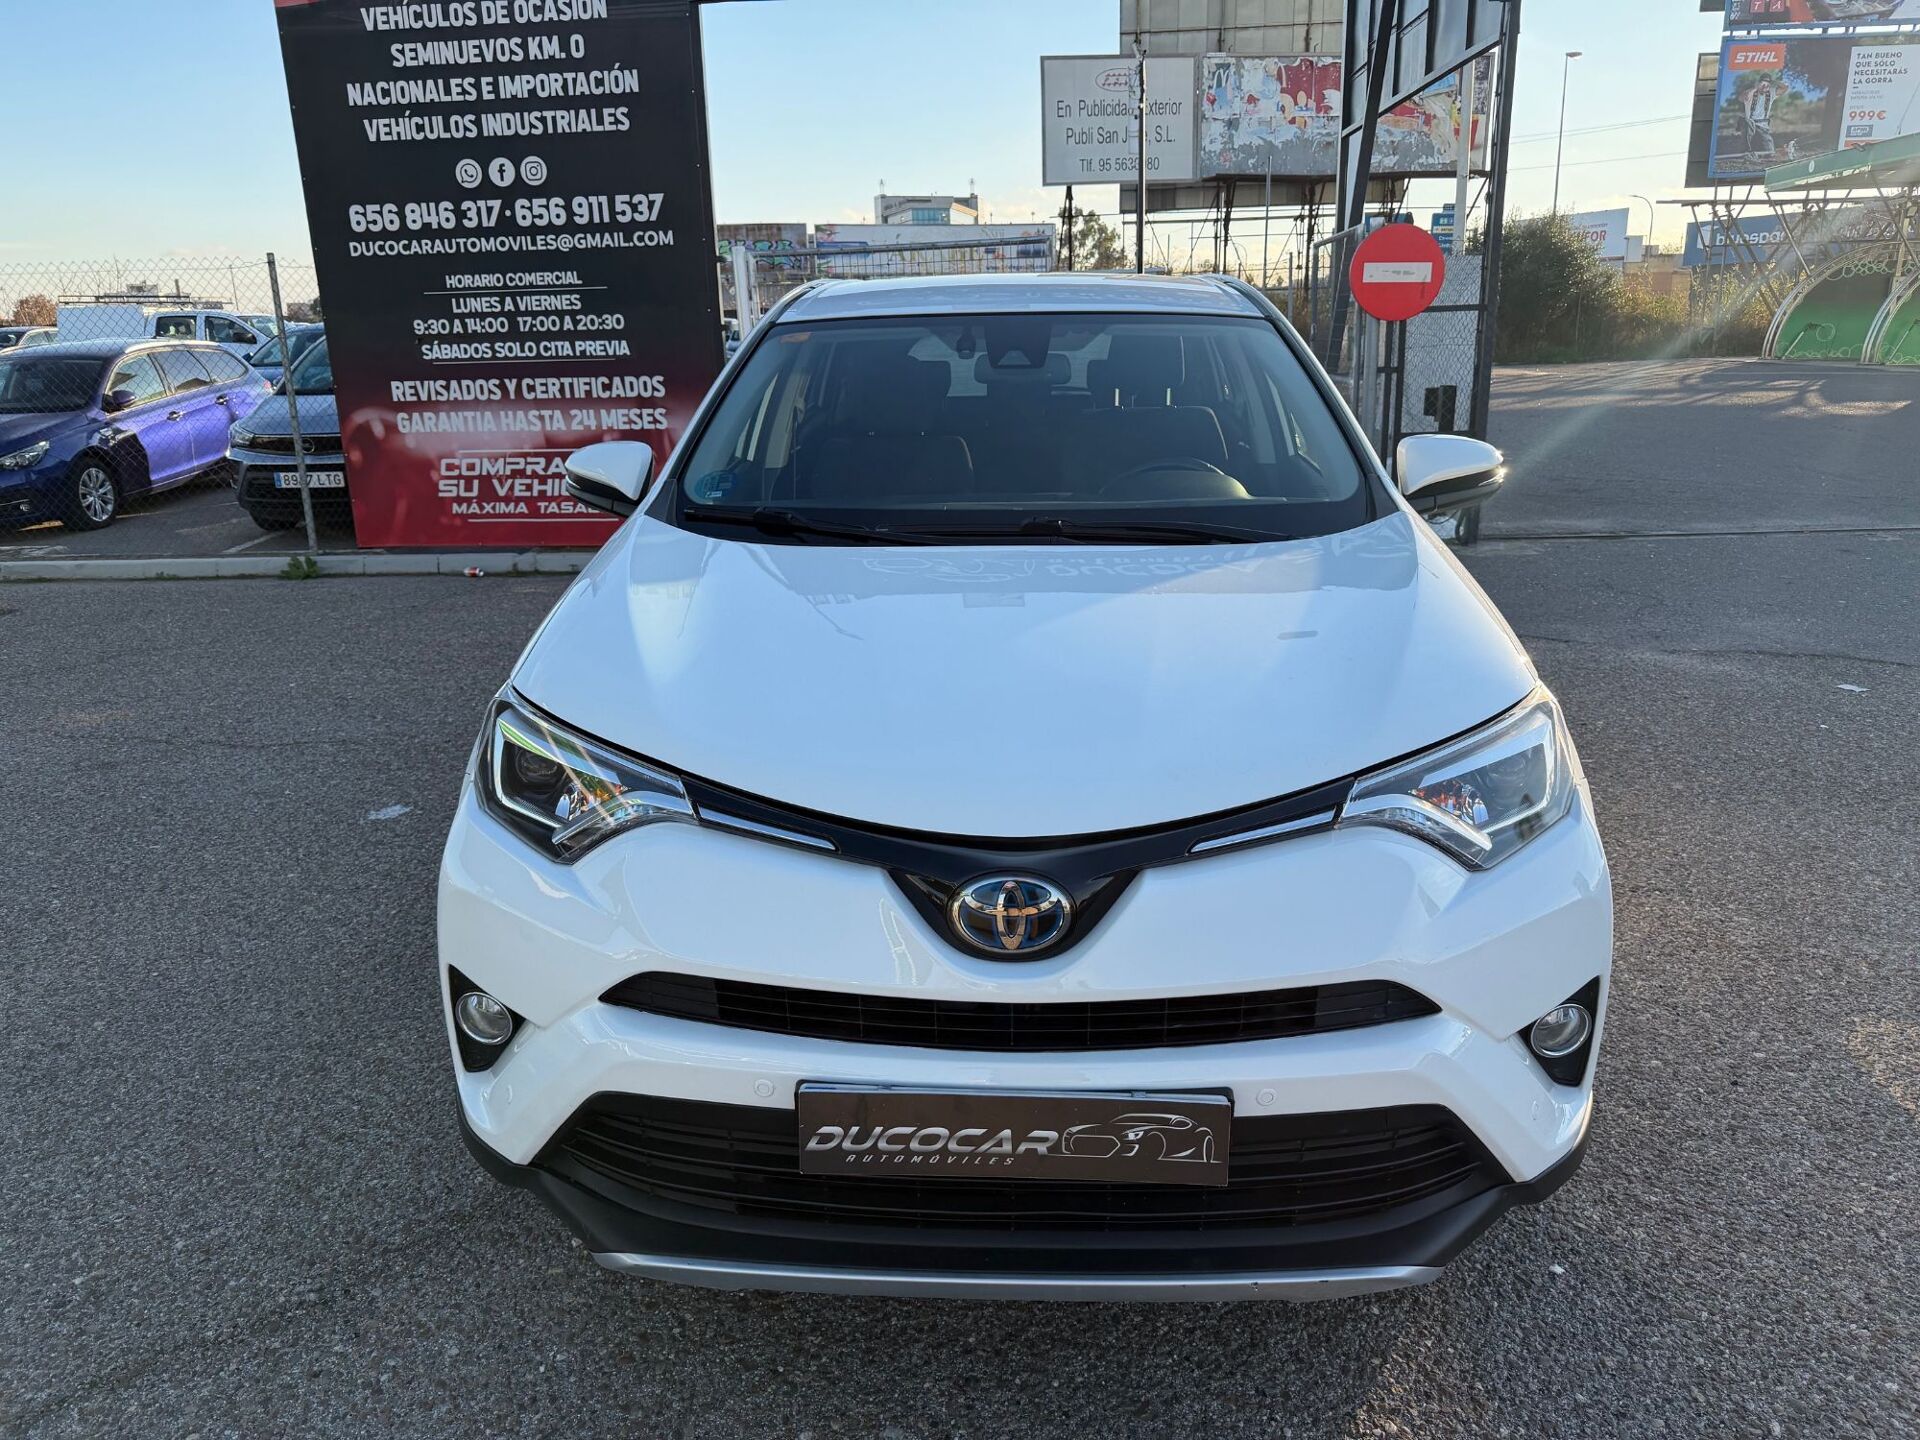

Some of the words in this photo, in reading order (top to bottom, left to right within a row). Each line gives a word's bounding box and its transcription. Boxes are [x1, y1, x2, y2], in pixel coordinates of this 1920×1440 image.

[481, 0, 511, 25] DE
[390, 37, 524, 68] SEMINUEVOS
[528, 36, 566, 61] KM.
[1734, 52, 1779, 64] STIHL
[1856, 52, 1872, 60] TAN
[1875, 51, 1903, 59] BUENO
[346, 78, 477, 107] NACIONALES
[482, 77, 495, 99] E
[499, 64, 639, 98] IMPORTACIÓN
[1057, 101, 1072, 118] En
[1849, 110, 1887, 121] 999€
[363, 109, 477, 141] VEHÍCULOS
[482, 107, 630, 137] INDUSTRIALES
[1066, 127, 1094, 145] Publi
[1097, 126, 1119, 144] San
[1155, 125, 1176, 143] S.L.
[1098, 158, 1112, 171] 95
[1115, 157, 1160, 171] 56380
[349, 204, 400, 232] 656
[405, 201, 456, 229] 846
[571, 195, 611, 223] 911
[615, 193, 664, 222] 537
[349, 230, 674, 257] DUCOCARAUTOMOVILES@GMAIL.COM
[445, 274, 503, 289] HORARIO
[505, 271, 583, 287] COMERCIAL
[452, 296, 501, 314] LUNES
[503, 296, 514, 311] A
[516, 294, 581, 312] VIERNES
[413, 318, 450, 335] 9:30
[452, 317, 464, 333] A
[466, 317, 509, 334] 14:00
[517, 315, 561, 332] 17:00
[563, 315, 574, 331] A
[576, 314, 625, 330] 20:30
[421, 342, 492, 361] SÁBADOS
[495, 341, 537, 358] SOLO
[540, 341, 573, 357] CITA
[576, 340, 631, 356] PREVIA
[391, 379, 501, 402] REVISADOS
[504, 379, 519, 400] Y
[521, 376, 665, 400] CERTIFICADOS
[396, 411, 495, 434] GARANTIA
[499, 409, 566, 432] HASTA
[570, 409, 597, 430] 24
[602, 408, 668, 430] MESES
[440, 457, 567, 476] COMPRA
[283, 474, 313, 486] 897
[317, 474, 342, 486] LTG
[438, 479, 479, 496] SU
[491, 478, 570, 497] VEHI
[452, 500, 529, 514] MÁXIMA
[536, 502, 603, 514] TASA
[804, 1126, 1060, 1155] DUCOCAR
[845, 1153, 1015, 1166] AUTOMÓVILES
